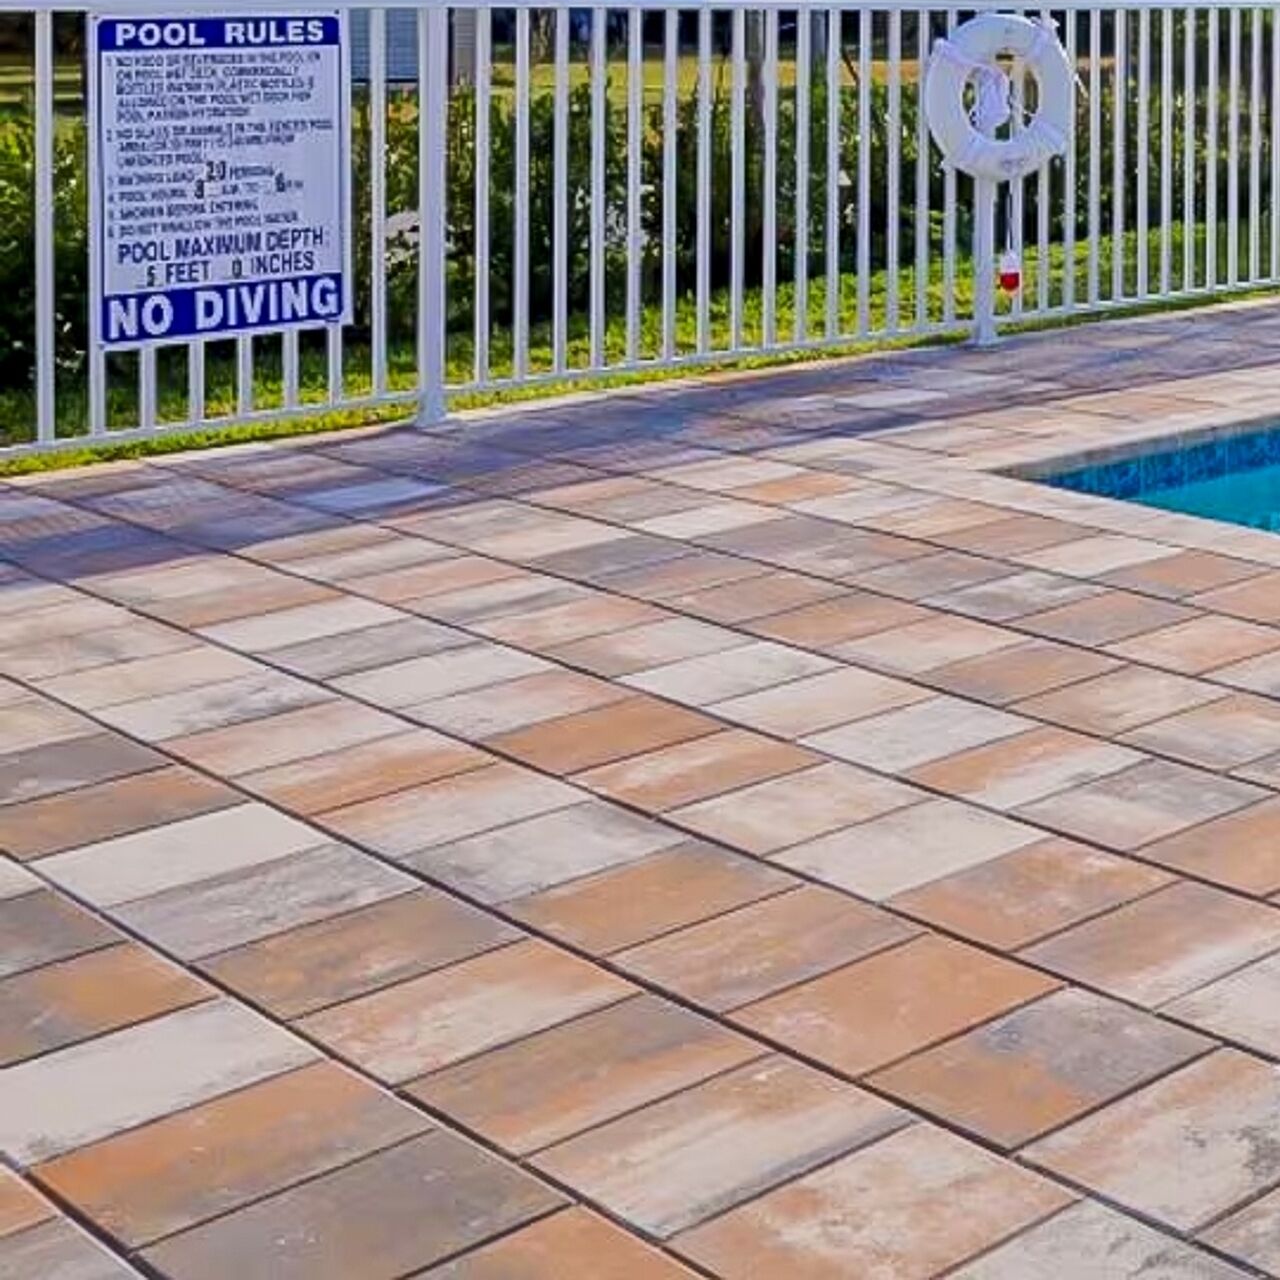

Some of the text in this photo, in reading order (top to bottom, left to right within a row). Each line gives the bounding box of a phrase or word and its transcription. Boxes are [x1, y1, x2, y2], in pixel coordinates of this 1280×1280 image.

[114, 20, 325, 47] POOL RULES
[118, 241, 171, 265] POOL
[175, 231, 262, 259] MAXIMUM
[146, 250, 315, 286] 5 FEET 0 INCHES
[108, 277, 341, 340] NO DIVING
